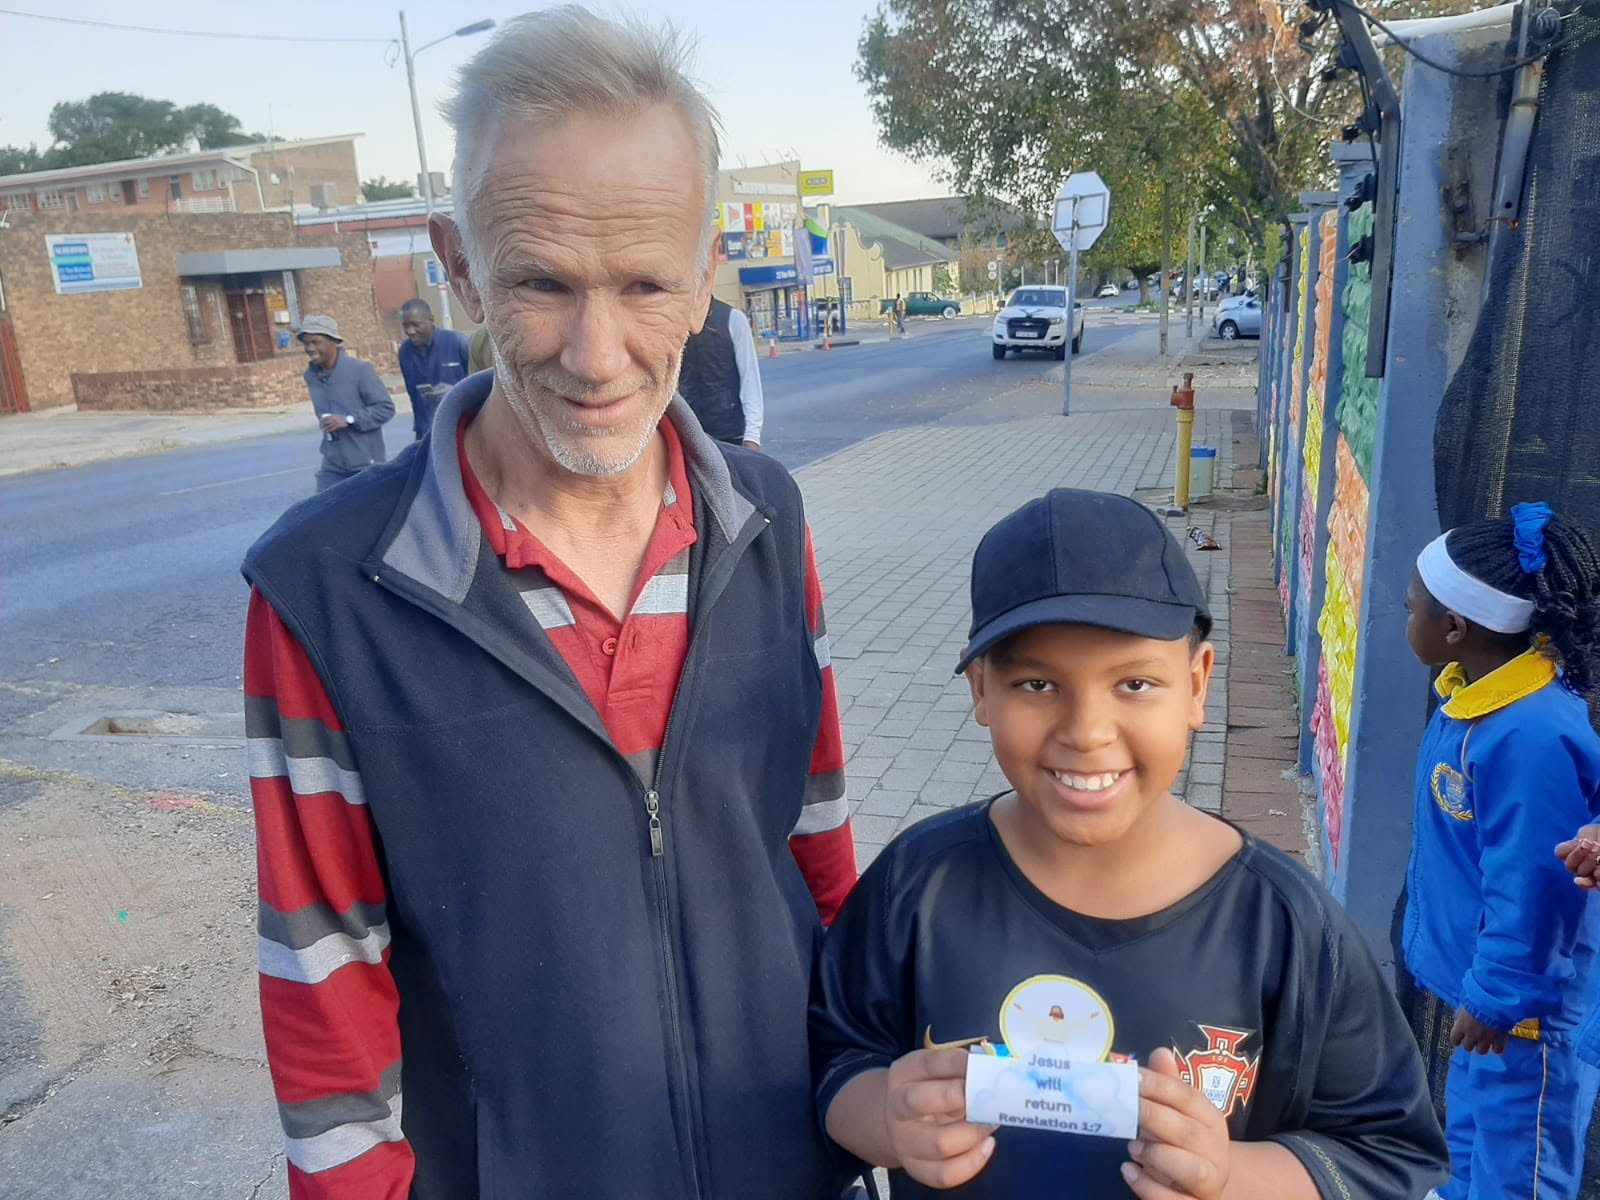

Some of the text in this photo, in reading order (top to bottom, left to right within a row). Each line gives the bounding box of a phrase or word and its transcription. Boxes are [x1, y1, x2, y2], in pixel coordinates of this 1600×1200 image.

[1028, 1054, 1071, 1070] Jesus
[1036, 1077, 1062, 1092] will
[1025, 1099, 1072, 1113] return
[999, 1113, 1103, 1133] Revelation 1:7
